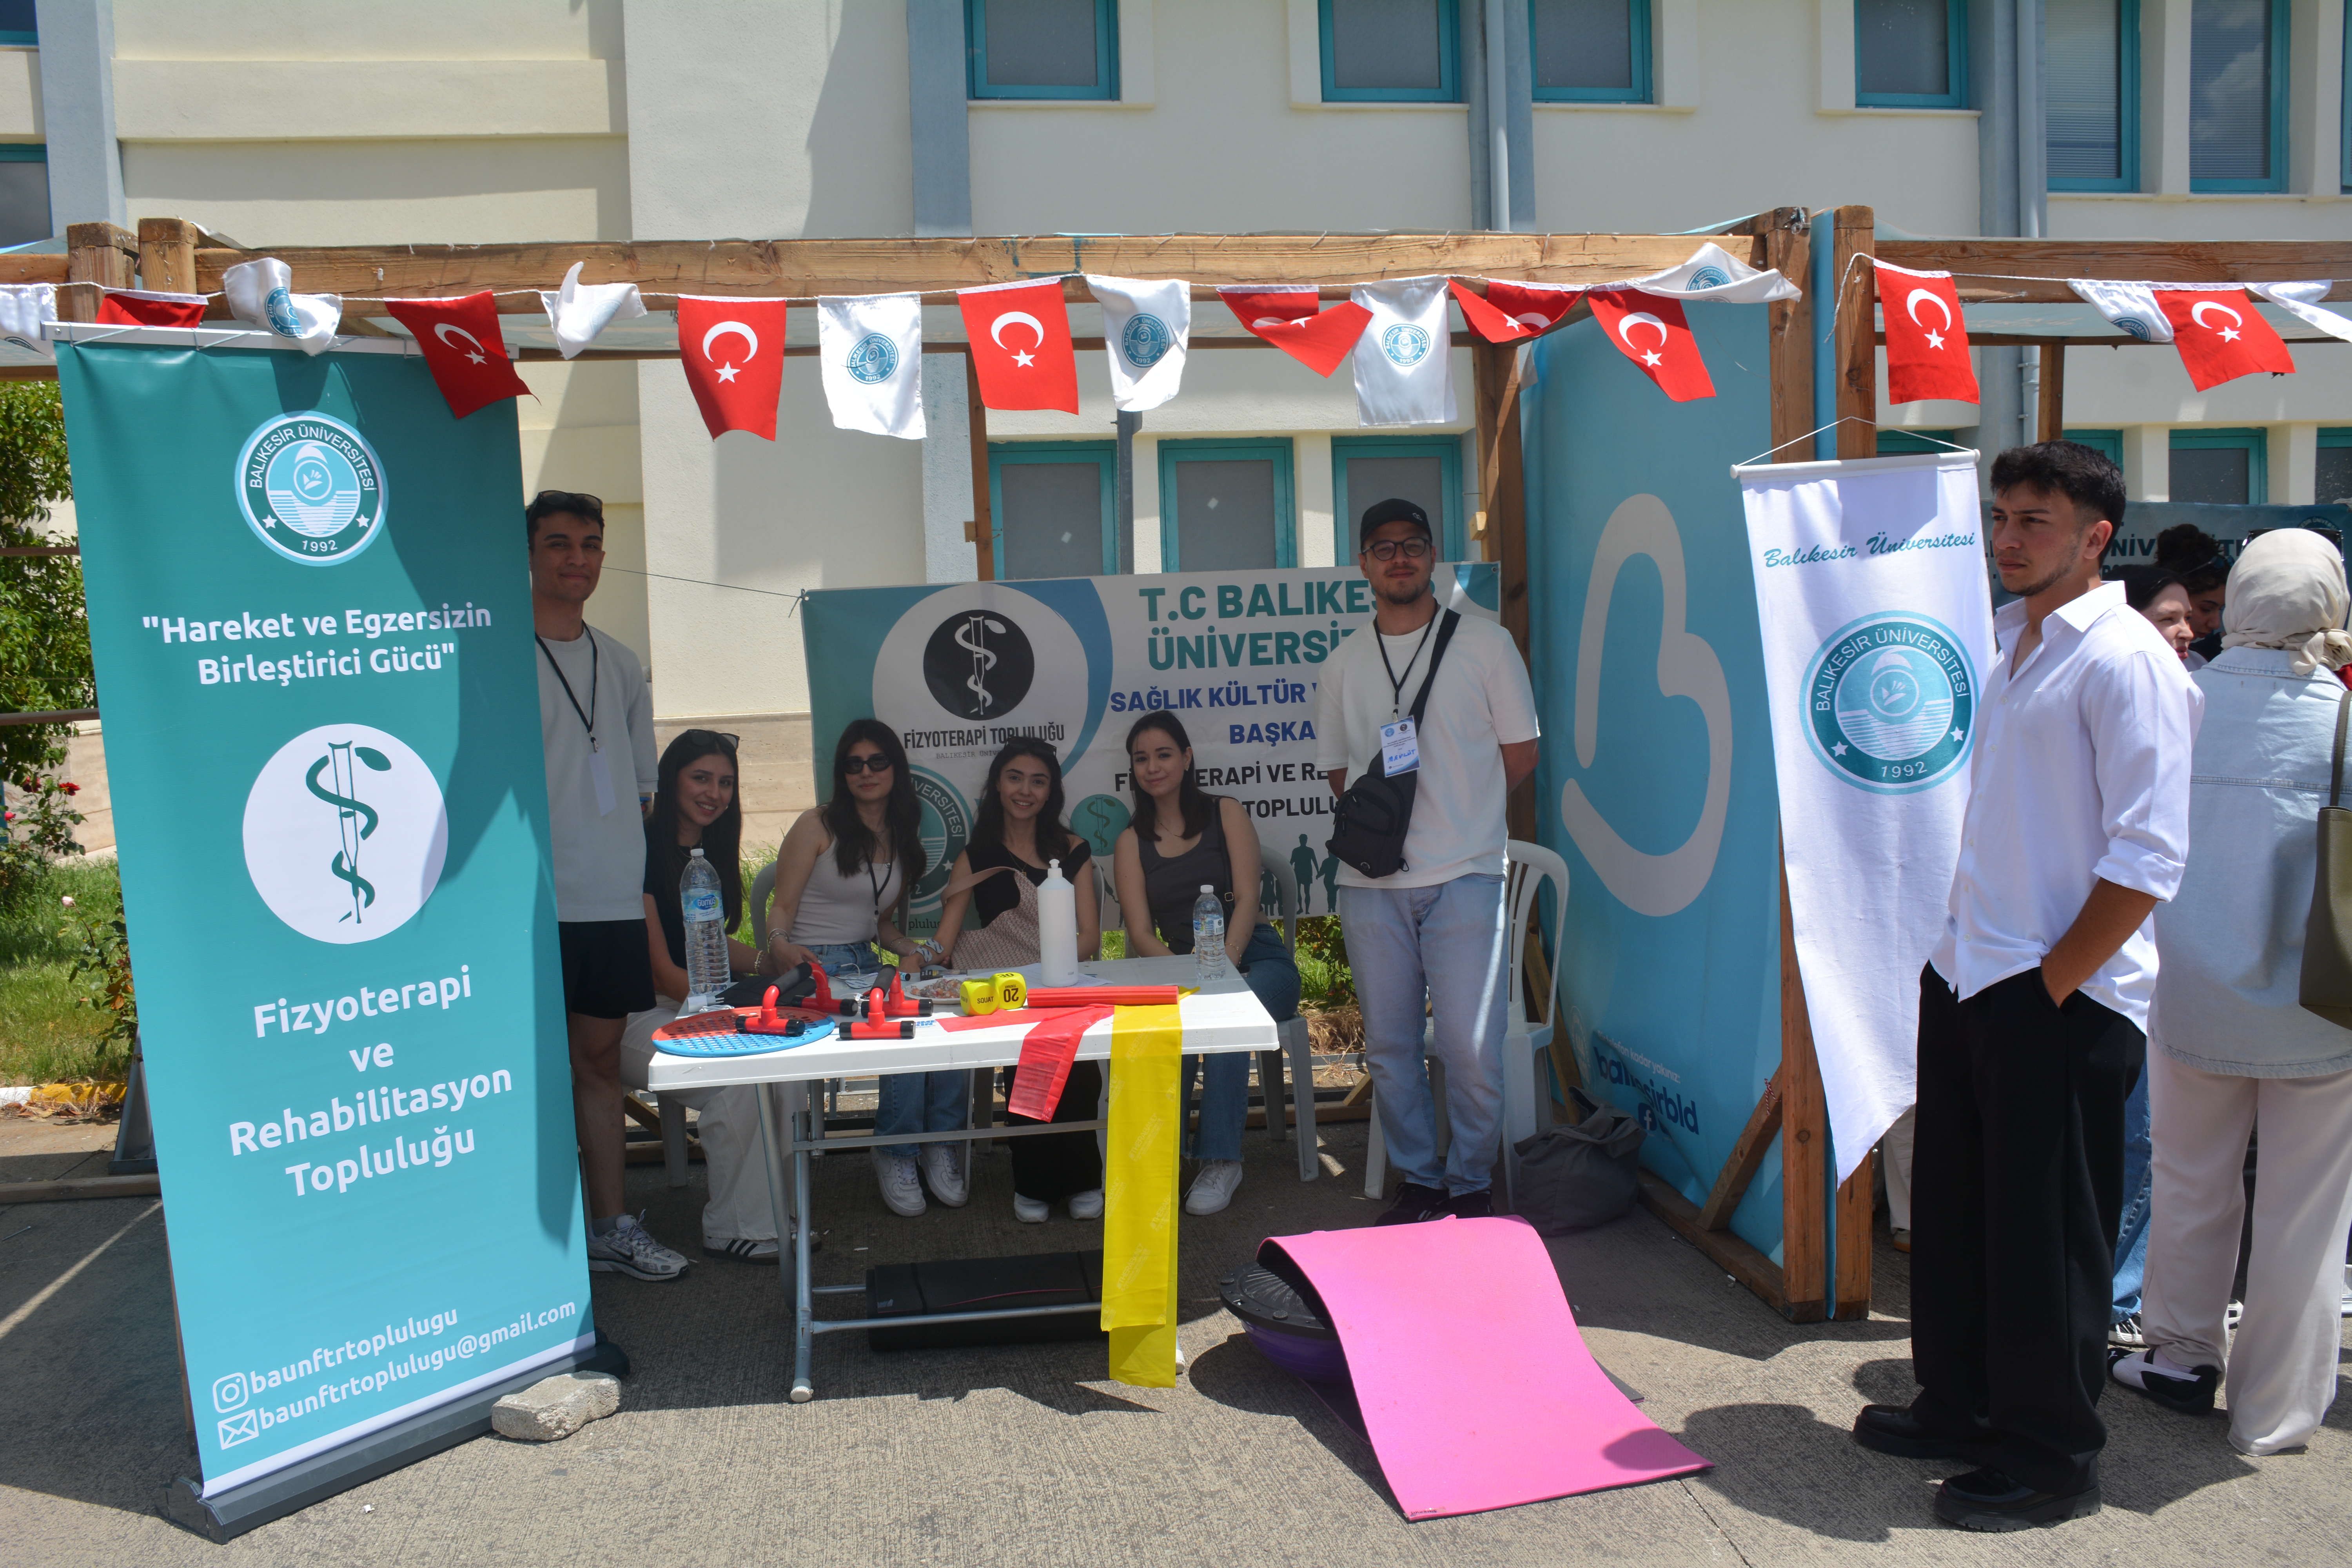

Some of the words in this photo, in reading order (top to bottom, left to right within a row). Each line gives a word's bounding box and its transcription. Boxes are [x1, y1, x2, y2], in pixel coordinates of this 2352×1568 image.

[250, 427, 296, 489] BALIKESİR
[298, 424, 377, 492] ÜNİVERSİTESİ
[301, 539, 338, 552] 1992
[1866, 532, 1975, 555] Üniversitesi
[1139, 586, 1206, 621] T.C
[1218, 580, 1435, 619] BALIKE
[143, 611, 295, 644] "Hareket
[302, 613, 338, 636] ve
[345, 603, 492, 641] Egzersizin
[198, 648, 361, 686] Birleştirici
[371, 642, 455, 675] Gücü"
[1148, 620, 1357, 671] ÜNİVERSİ
[1816, 634, 1870, 711] BALIKESİR
[1875, 627, 1970, 697] ÜNİVERSİTESİ
[1111, 686, 1202, 712] SAĞLIK
[1209, 678, 1306, 707] KÜLTÜR
[904, 726, 987, 749] FİZYOTERAPİ
[936, 750, 975, 759] BALIKESİR
[1267, 764, 1296, 782] VE
[1882, 761, 1927, 778] 1992
[911, 778, 965, 837] VERSİTESİ
[254, 964, 471, 1038] Fizyoterapi
[1003, 987, 1019, 1002] 20
[349, 1042, 394, 1072] ve
[1181, 1033, 1214, 1045] LASTİK
[1630, 1047, 1651, 1069] kadar
[229, 1069, 512, 1155] Rehabilitasyon
[285, 1126, 475, 1196] Topluluğu
[251, 1308, 458, 1394] baunftrtoplulugu
[258, 1301, 576, 1430] baunftrtoplulugu@gmail.com
